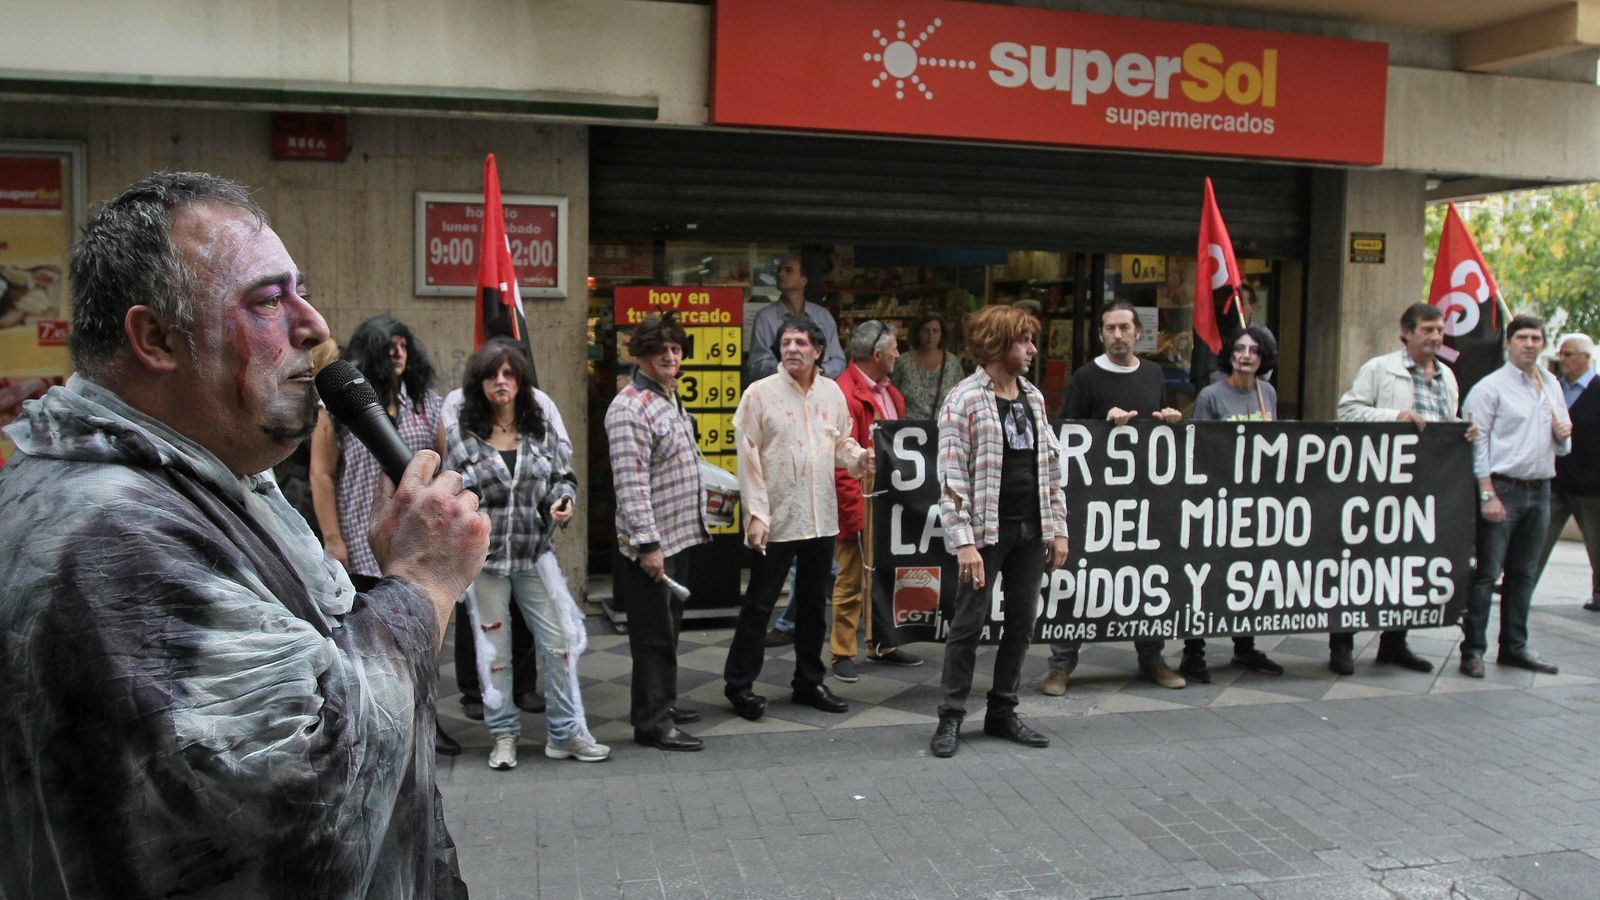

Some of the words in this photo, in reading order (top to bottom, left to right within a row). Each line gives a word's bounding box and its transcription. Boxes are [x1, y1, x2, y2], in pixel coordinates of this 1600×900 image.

[989, 42, 1278, 107] superSol
[1106, 106, 1275, 134] supermercados
[442, 222, 478, 232] lunes
[430, 237, 474, 265] 9:00
[511, 239, 553, 267] 2:00
[648, 289, 682, 308] hoy
[688, 292, 710, 304] en
[1085, 499, 1161, 552] DEL
[1341, 494, 1436, 545] CON
[1184, 562, 1211, 613] Y
[896, 609, 935, 623] CGT
[1041, 622, 1097, 640] HORAS
[1216, 616, 1228, 633] A
[1232, 614, 1251, 633] LA
[1254, 612, 1329, 632] CREACION
[1341, 610, 1369, 628] DEL
